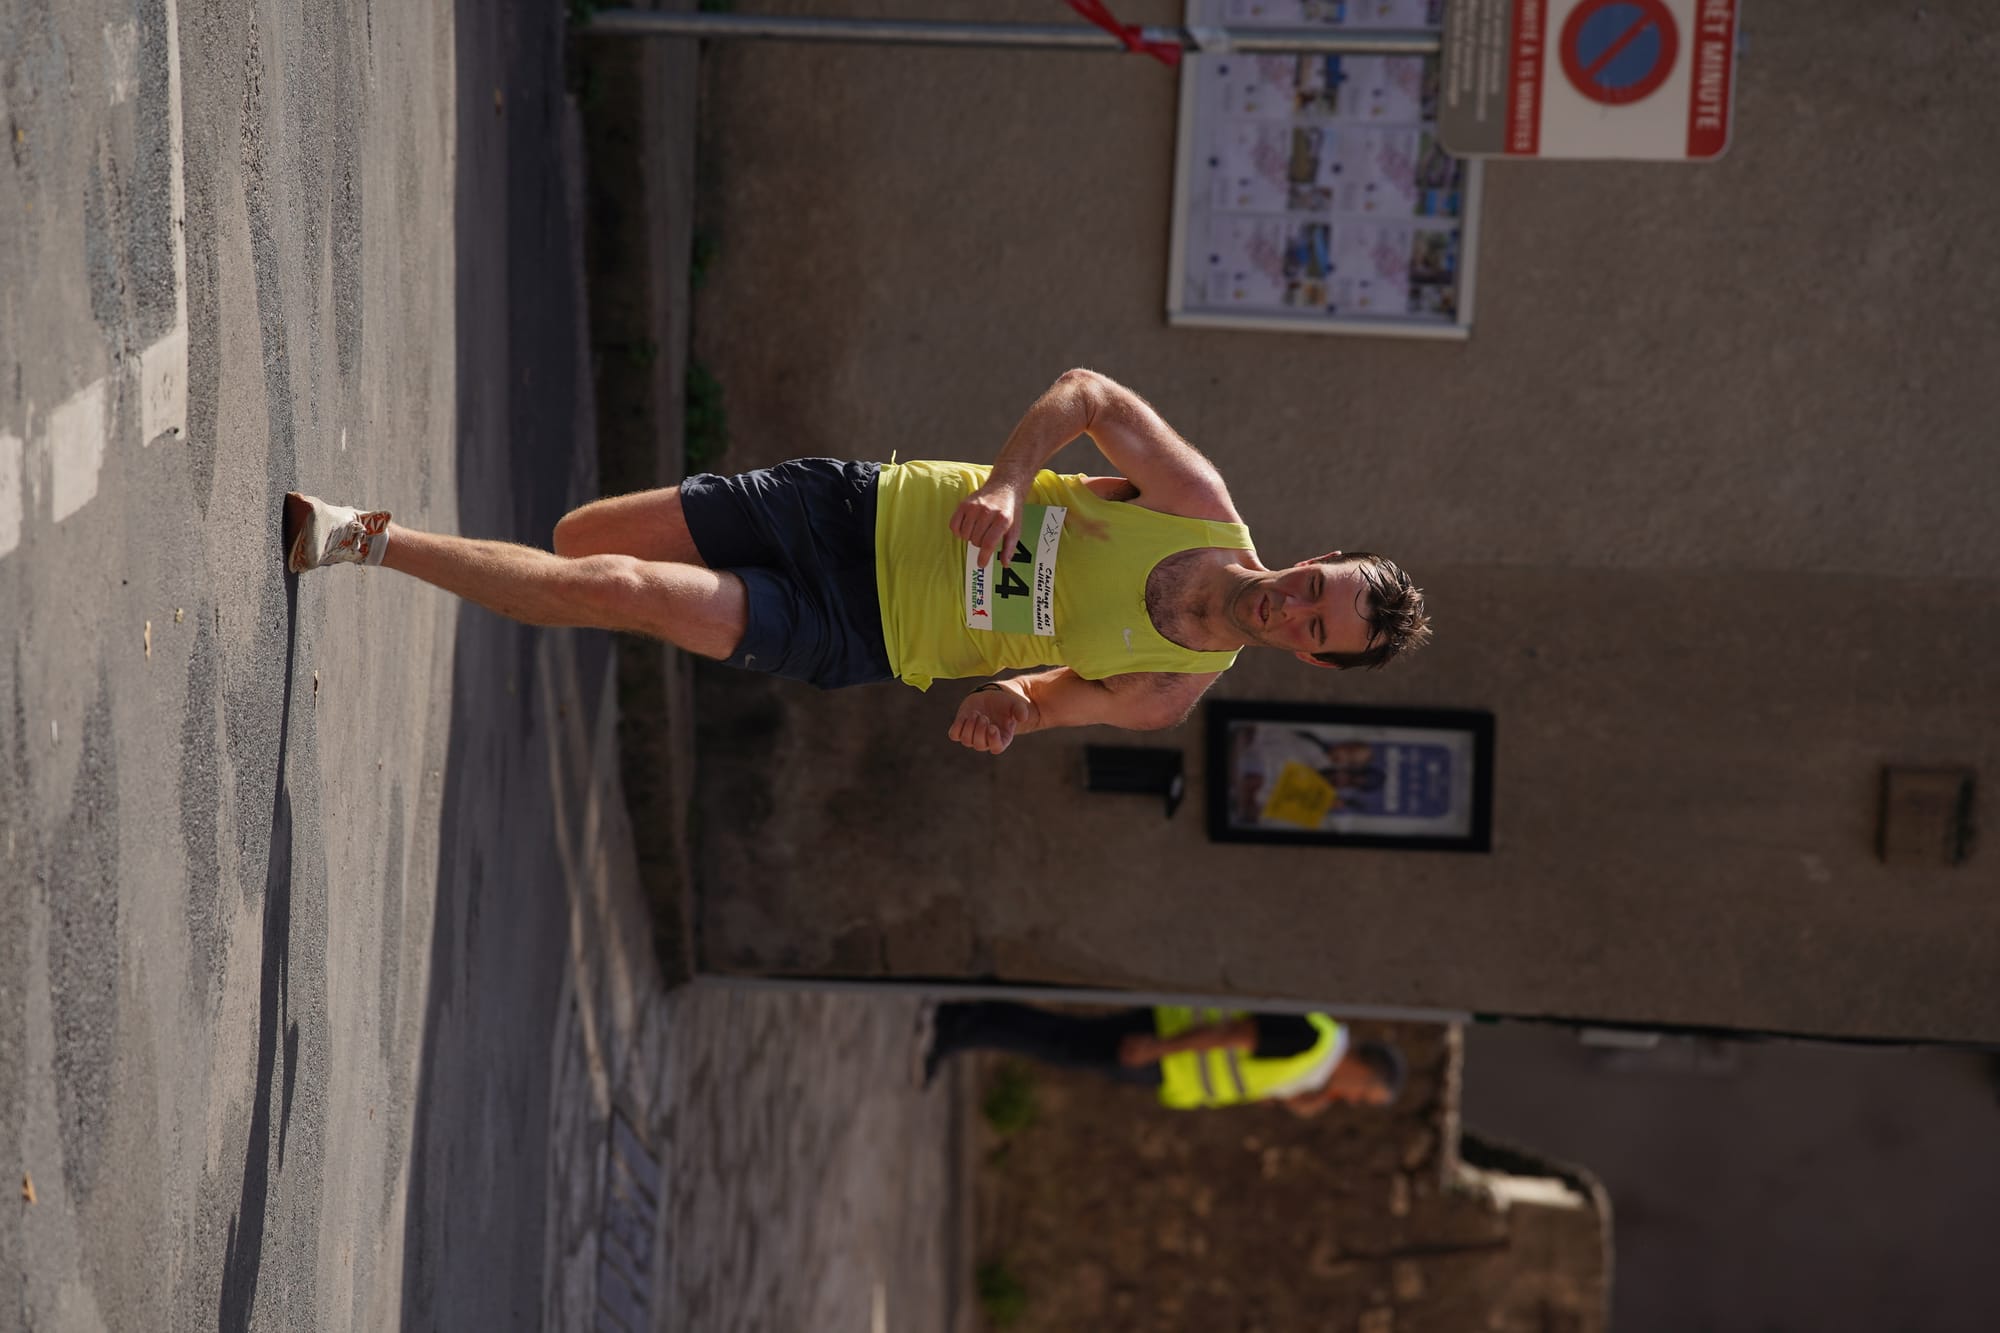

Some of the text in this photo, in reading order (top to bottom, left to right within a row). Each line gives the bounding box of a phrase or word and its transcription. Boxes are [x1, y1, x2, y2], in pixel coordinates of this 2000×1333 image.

[1696, 42, 1725, 129] MINUTE
[1513, 81, 1534, 151] MINUTES
[976, 567, 984, 606] TUFF'S
[1043, 567, 1052, 609] Challenge
